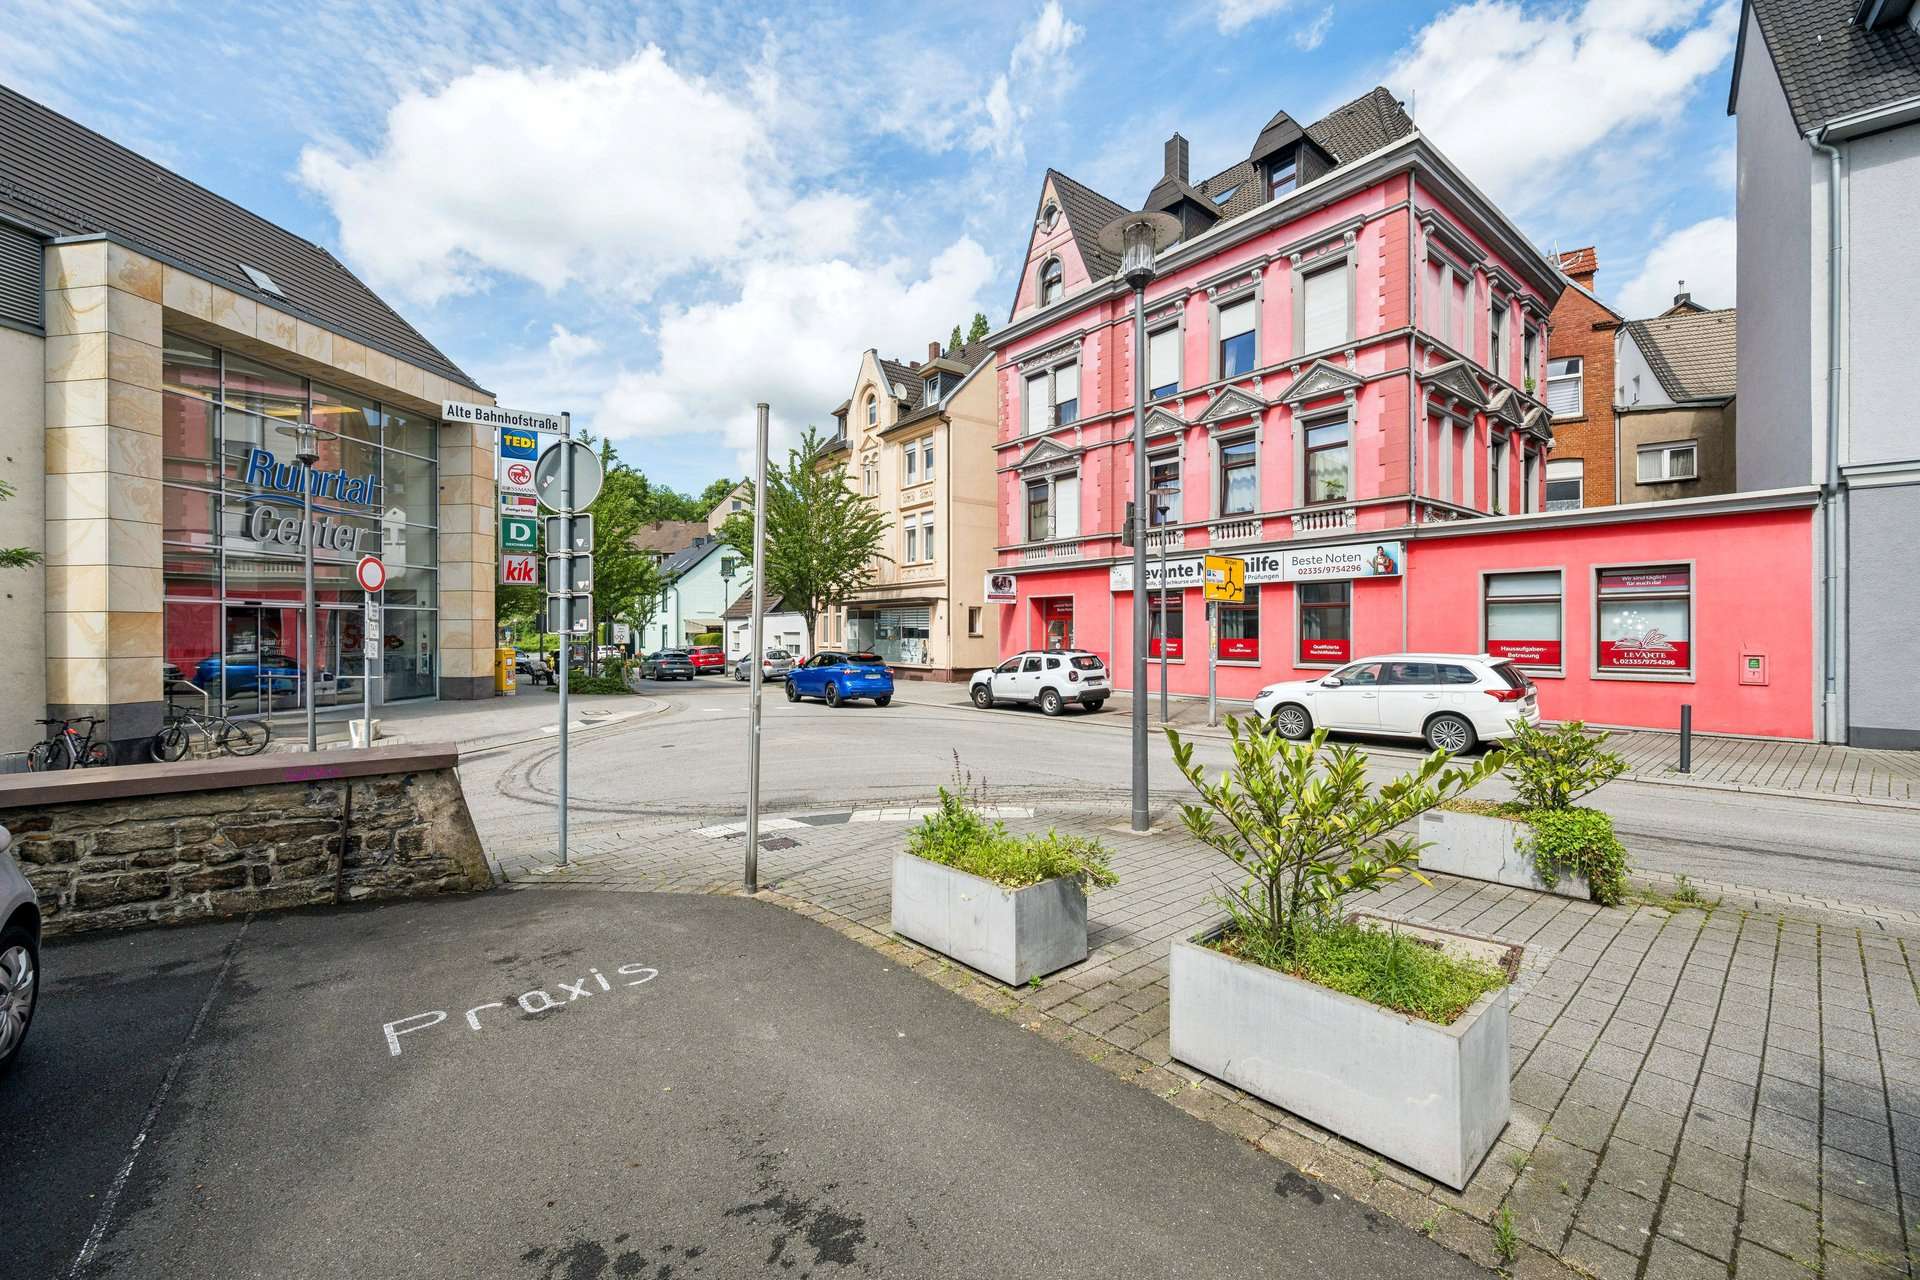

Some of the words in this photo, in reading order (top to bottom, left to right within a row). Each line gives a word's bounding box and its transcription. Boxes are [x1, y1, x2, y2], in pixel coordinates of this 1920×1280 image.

[447, 404, 471, 419] Alte
[475, 408, 558, 430] Bahnhofstraße
[245, 447, 376, 505] Ruhrtal
[251, 505, 368, 552] Center
[510, 522, 531, 541] D
[1291, 555, 1323, 566] Beste
[1325, 553, 1362, 563] Noten
[1298, 565, 1361, 575] 02335/9754296
[1624, 651, 1667, 659] LEVANTE
[383, 963, 659, 1056] Praxis
